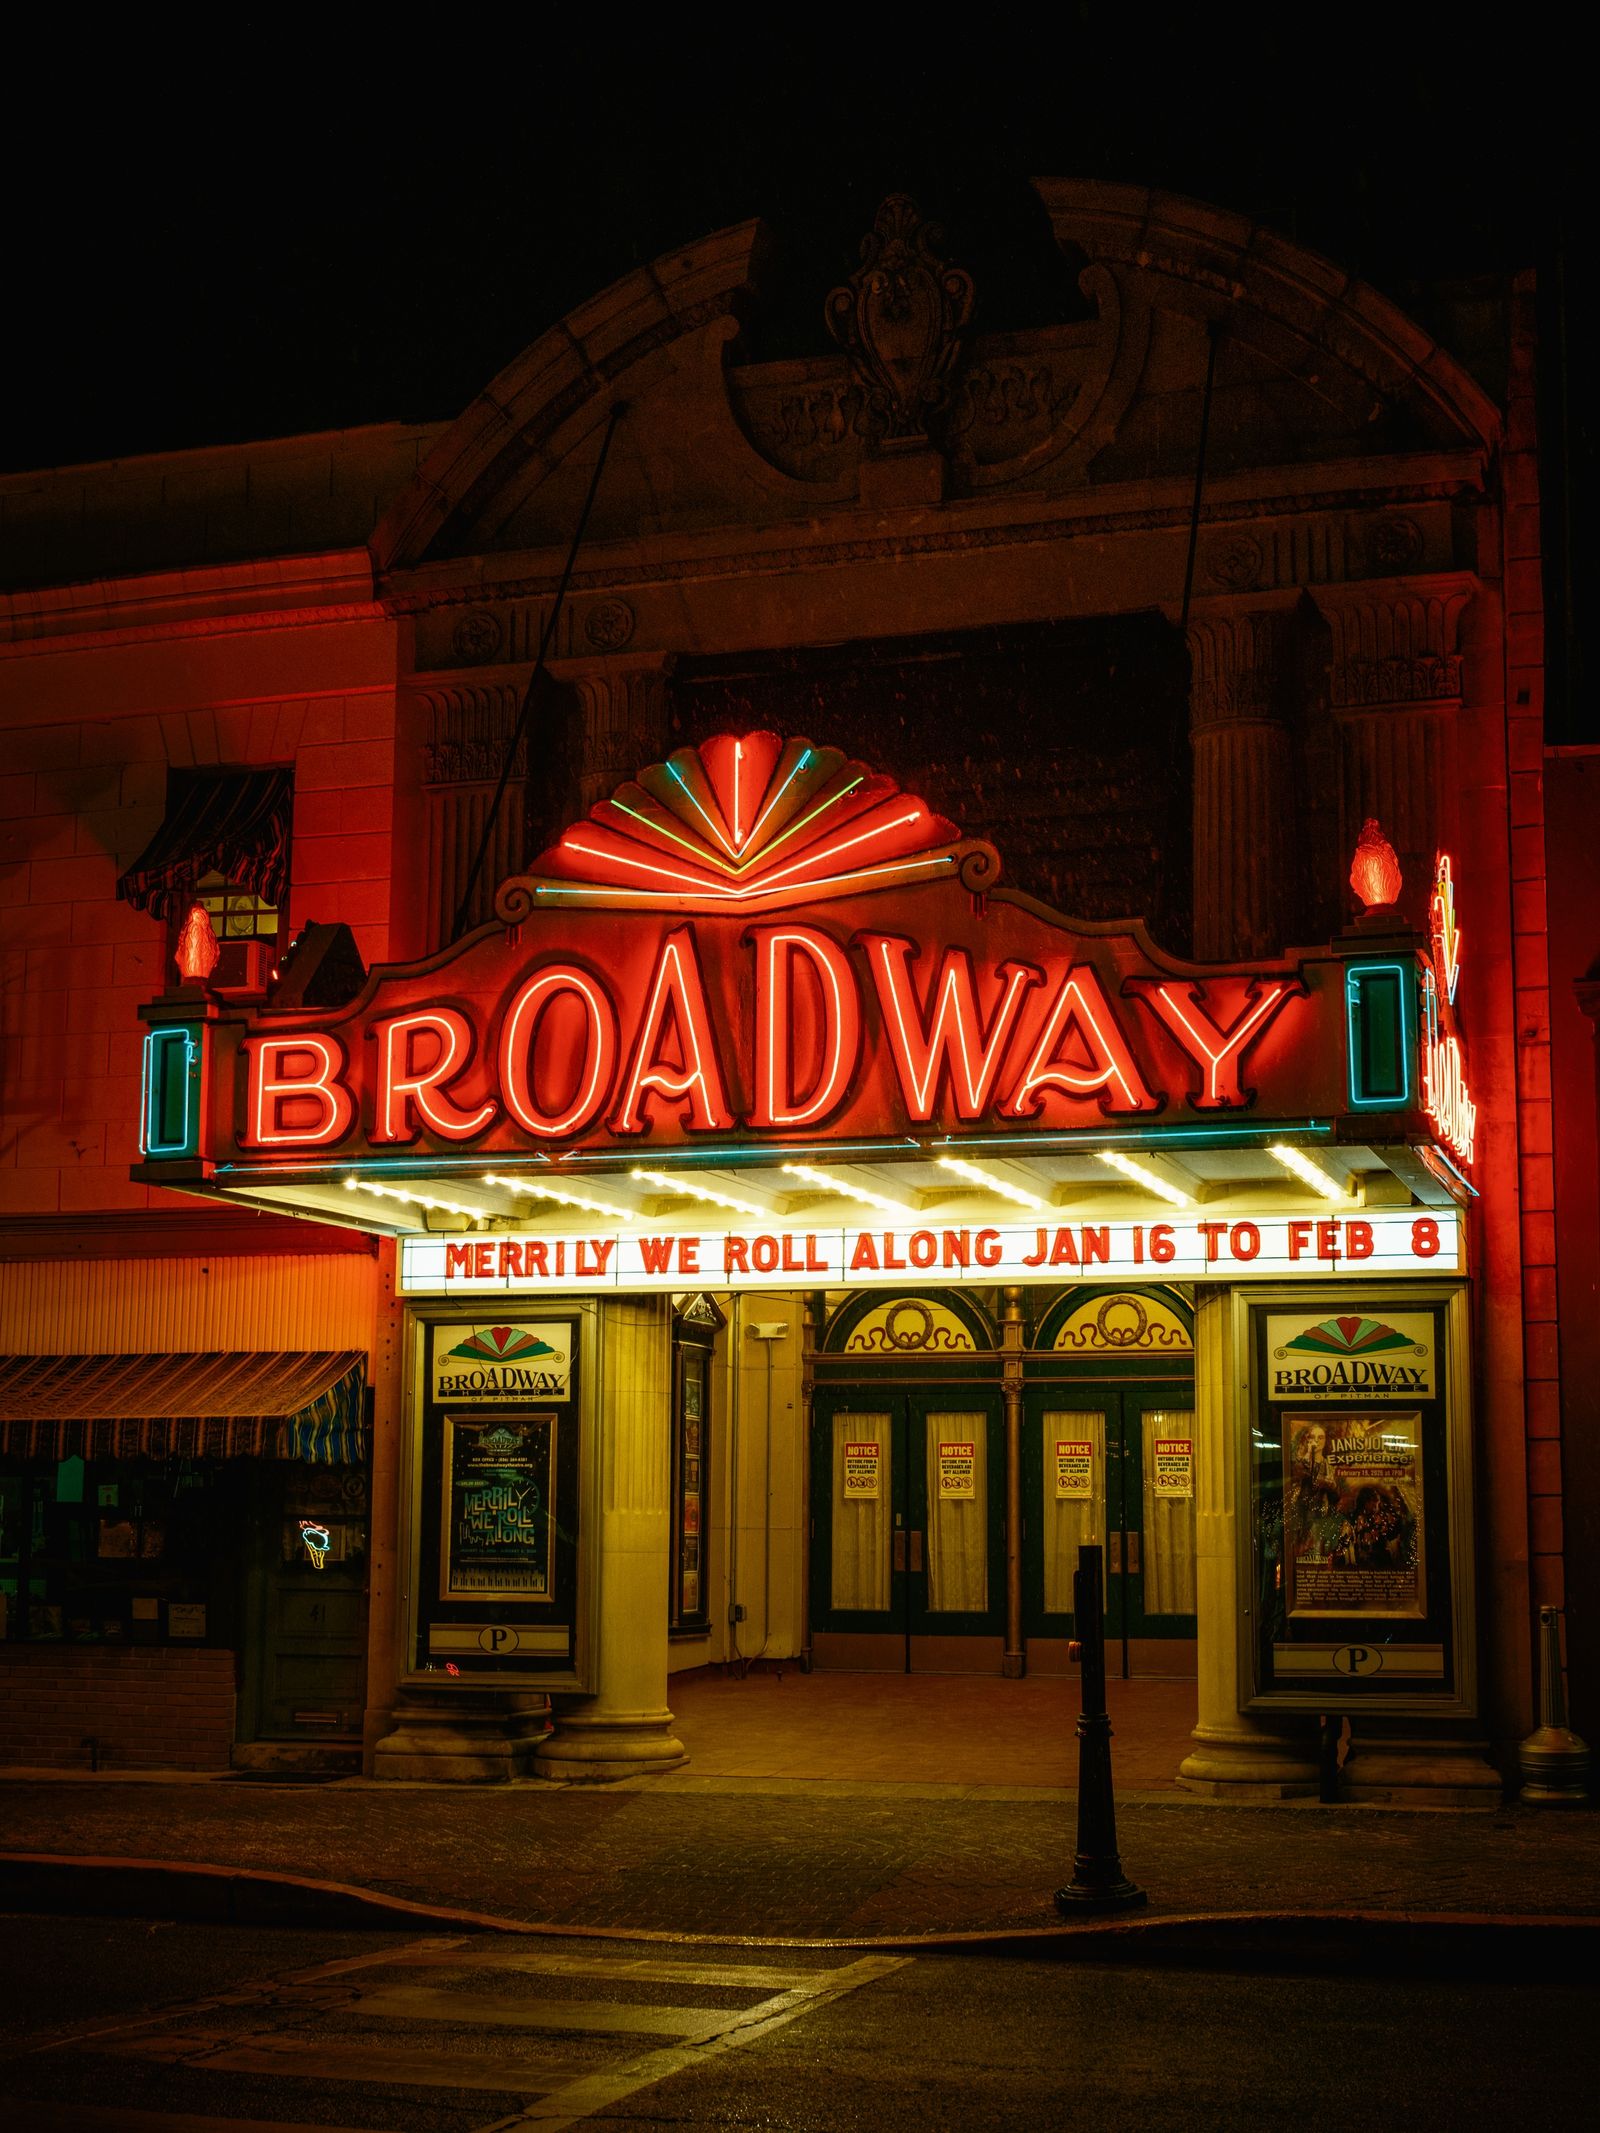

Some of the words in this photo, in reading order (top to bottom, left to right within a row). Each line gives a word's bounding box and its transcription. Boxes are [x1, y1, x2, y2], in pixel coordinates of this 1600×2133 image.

[241, 925, 1303, 1148] BROADWAY
[446, 1239, 615, 1278] MERRILY
[638, 1237, 701, 1275] WE
[725, 1234, 829, 1274] ROLL
[850, 1229, 1003, 1270] ALONG
[1021, 1226, 1110, 1267] JAN
[1132, 1224, 1175, 1264] 16
[1198, 1221, 1261, 1262] TO
[1288, 1219, 1375, 1261] FEB
[1411, 1217, 1440, 1259] 8
[438, 1367, 564, 1390] BROADWAY
[1275, 1361, 1428, 1385] BROADWAY
[444, 1388, 559, 1397] THEATRE
[848, 1446, 877, 1455] NOTICE
[942, 1446, 972, 1456] NOTICE
[1058, 1444, 1090, 1454] NOTICE
[1158, 1443, 1190, 1453] NOTICE
[1331, 1438, 1364, 1452] JANIS
[468, 1511, 494, 1529] WE
[486, 1527, 535, 1545] ALONG
[491, 1629, 507, 1651] P
[1347, 1648, 1368, 1673] P
